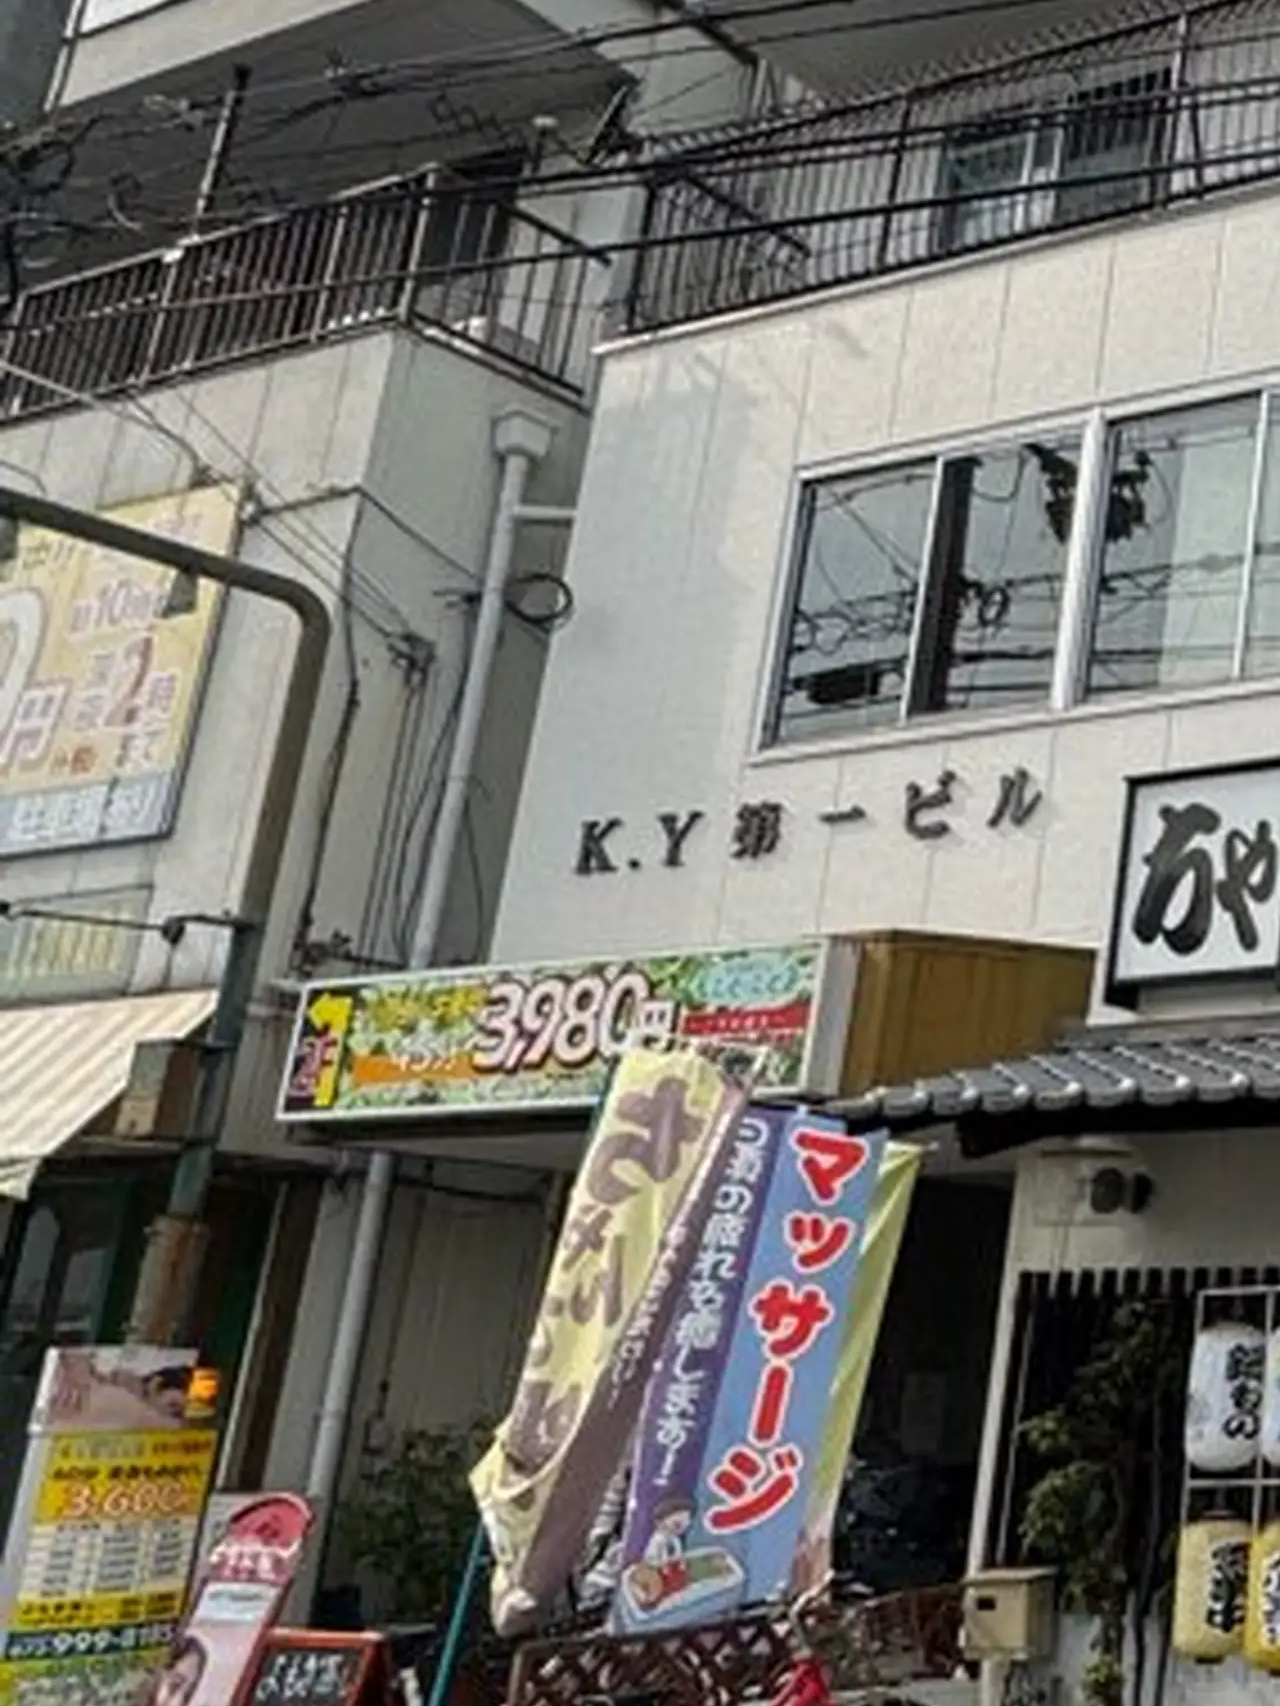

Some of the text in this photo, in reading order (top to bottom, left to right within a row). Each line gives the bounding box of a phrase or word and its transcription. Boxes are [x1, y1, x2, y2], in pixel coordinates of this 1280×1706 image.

[704, 1129, 868, 1533] マッサージ
